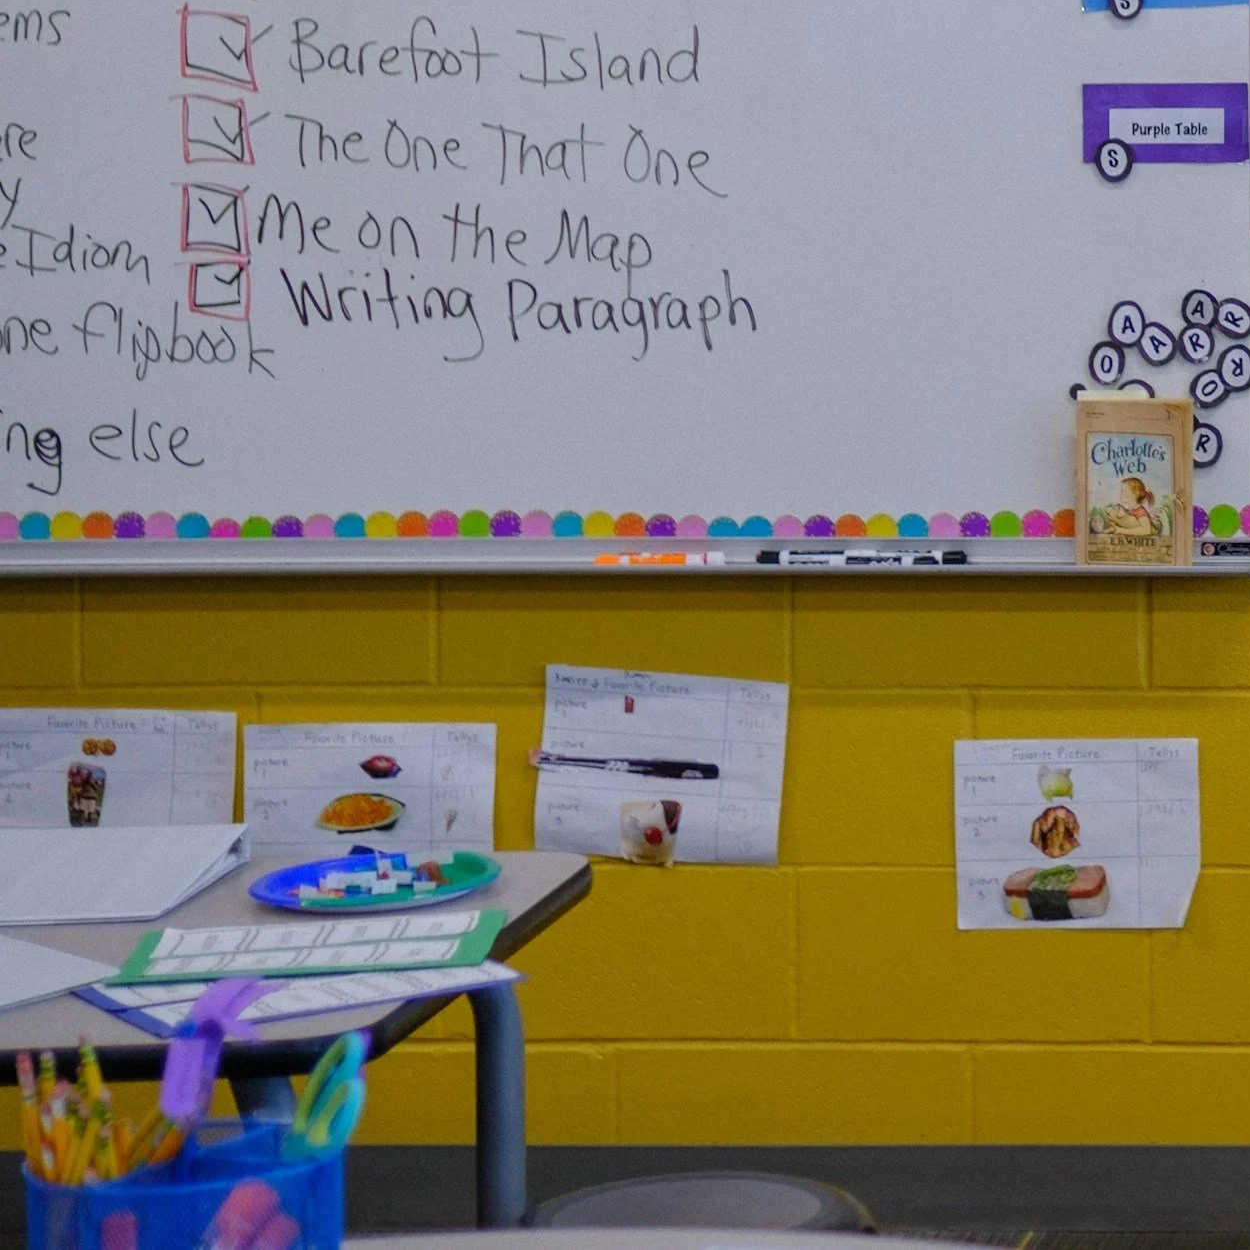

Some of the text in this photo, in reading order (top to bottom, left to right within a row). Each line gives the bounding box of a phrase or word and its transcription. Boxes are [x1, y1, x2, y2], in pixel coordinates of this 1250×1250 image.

[289, 16, 700, 90] Barefoot Island
[285, 114, 729, 199] The One That One
[1132, 122, 1207, 137] Purple Table
[12, 224, 150, 285] Idiom
[258, 194, 651, 296] Me on the Map
[73, 301, 275, 381] flipbook
[280, 268, 757, 362] Writing Paragraph
[90, 408, 204, 466] else
[1091, 438, 1166, 465] Charlotte's
[1113, 458, 1146, 476] Web
[1126, 538, 1156, 546] WHITE
